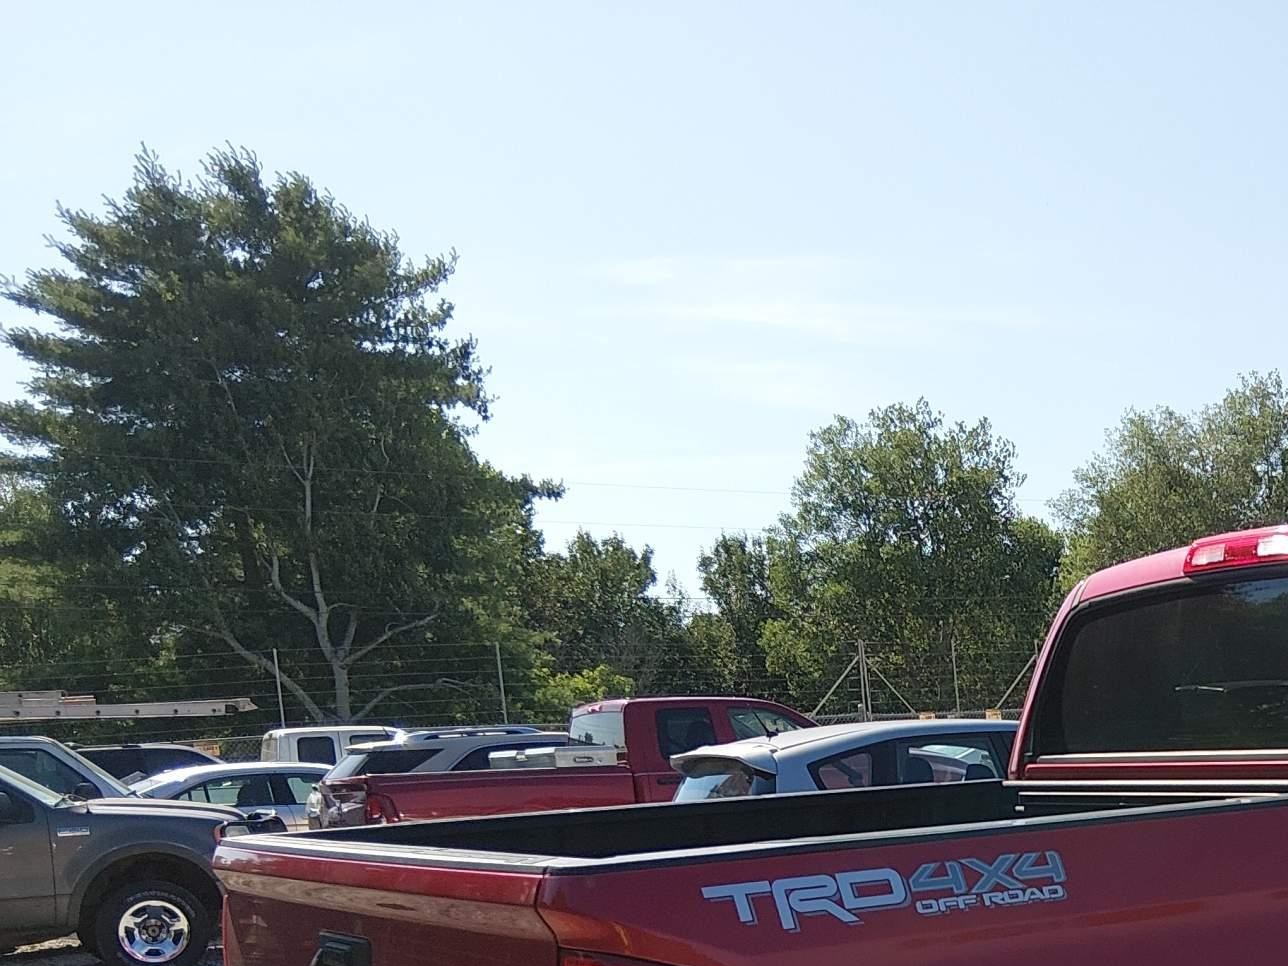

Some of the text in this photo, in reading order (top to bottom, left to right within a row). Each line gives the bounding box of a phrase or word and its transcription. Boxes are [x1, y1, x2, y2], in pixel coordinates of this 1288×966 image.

[701, 868, 910, 934] TRD
[915, 885, 1067, 916] OFF ROAD
